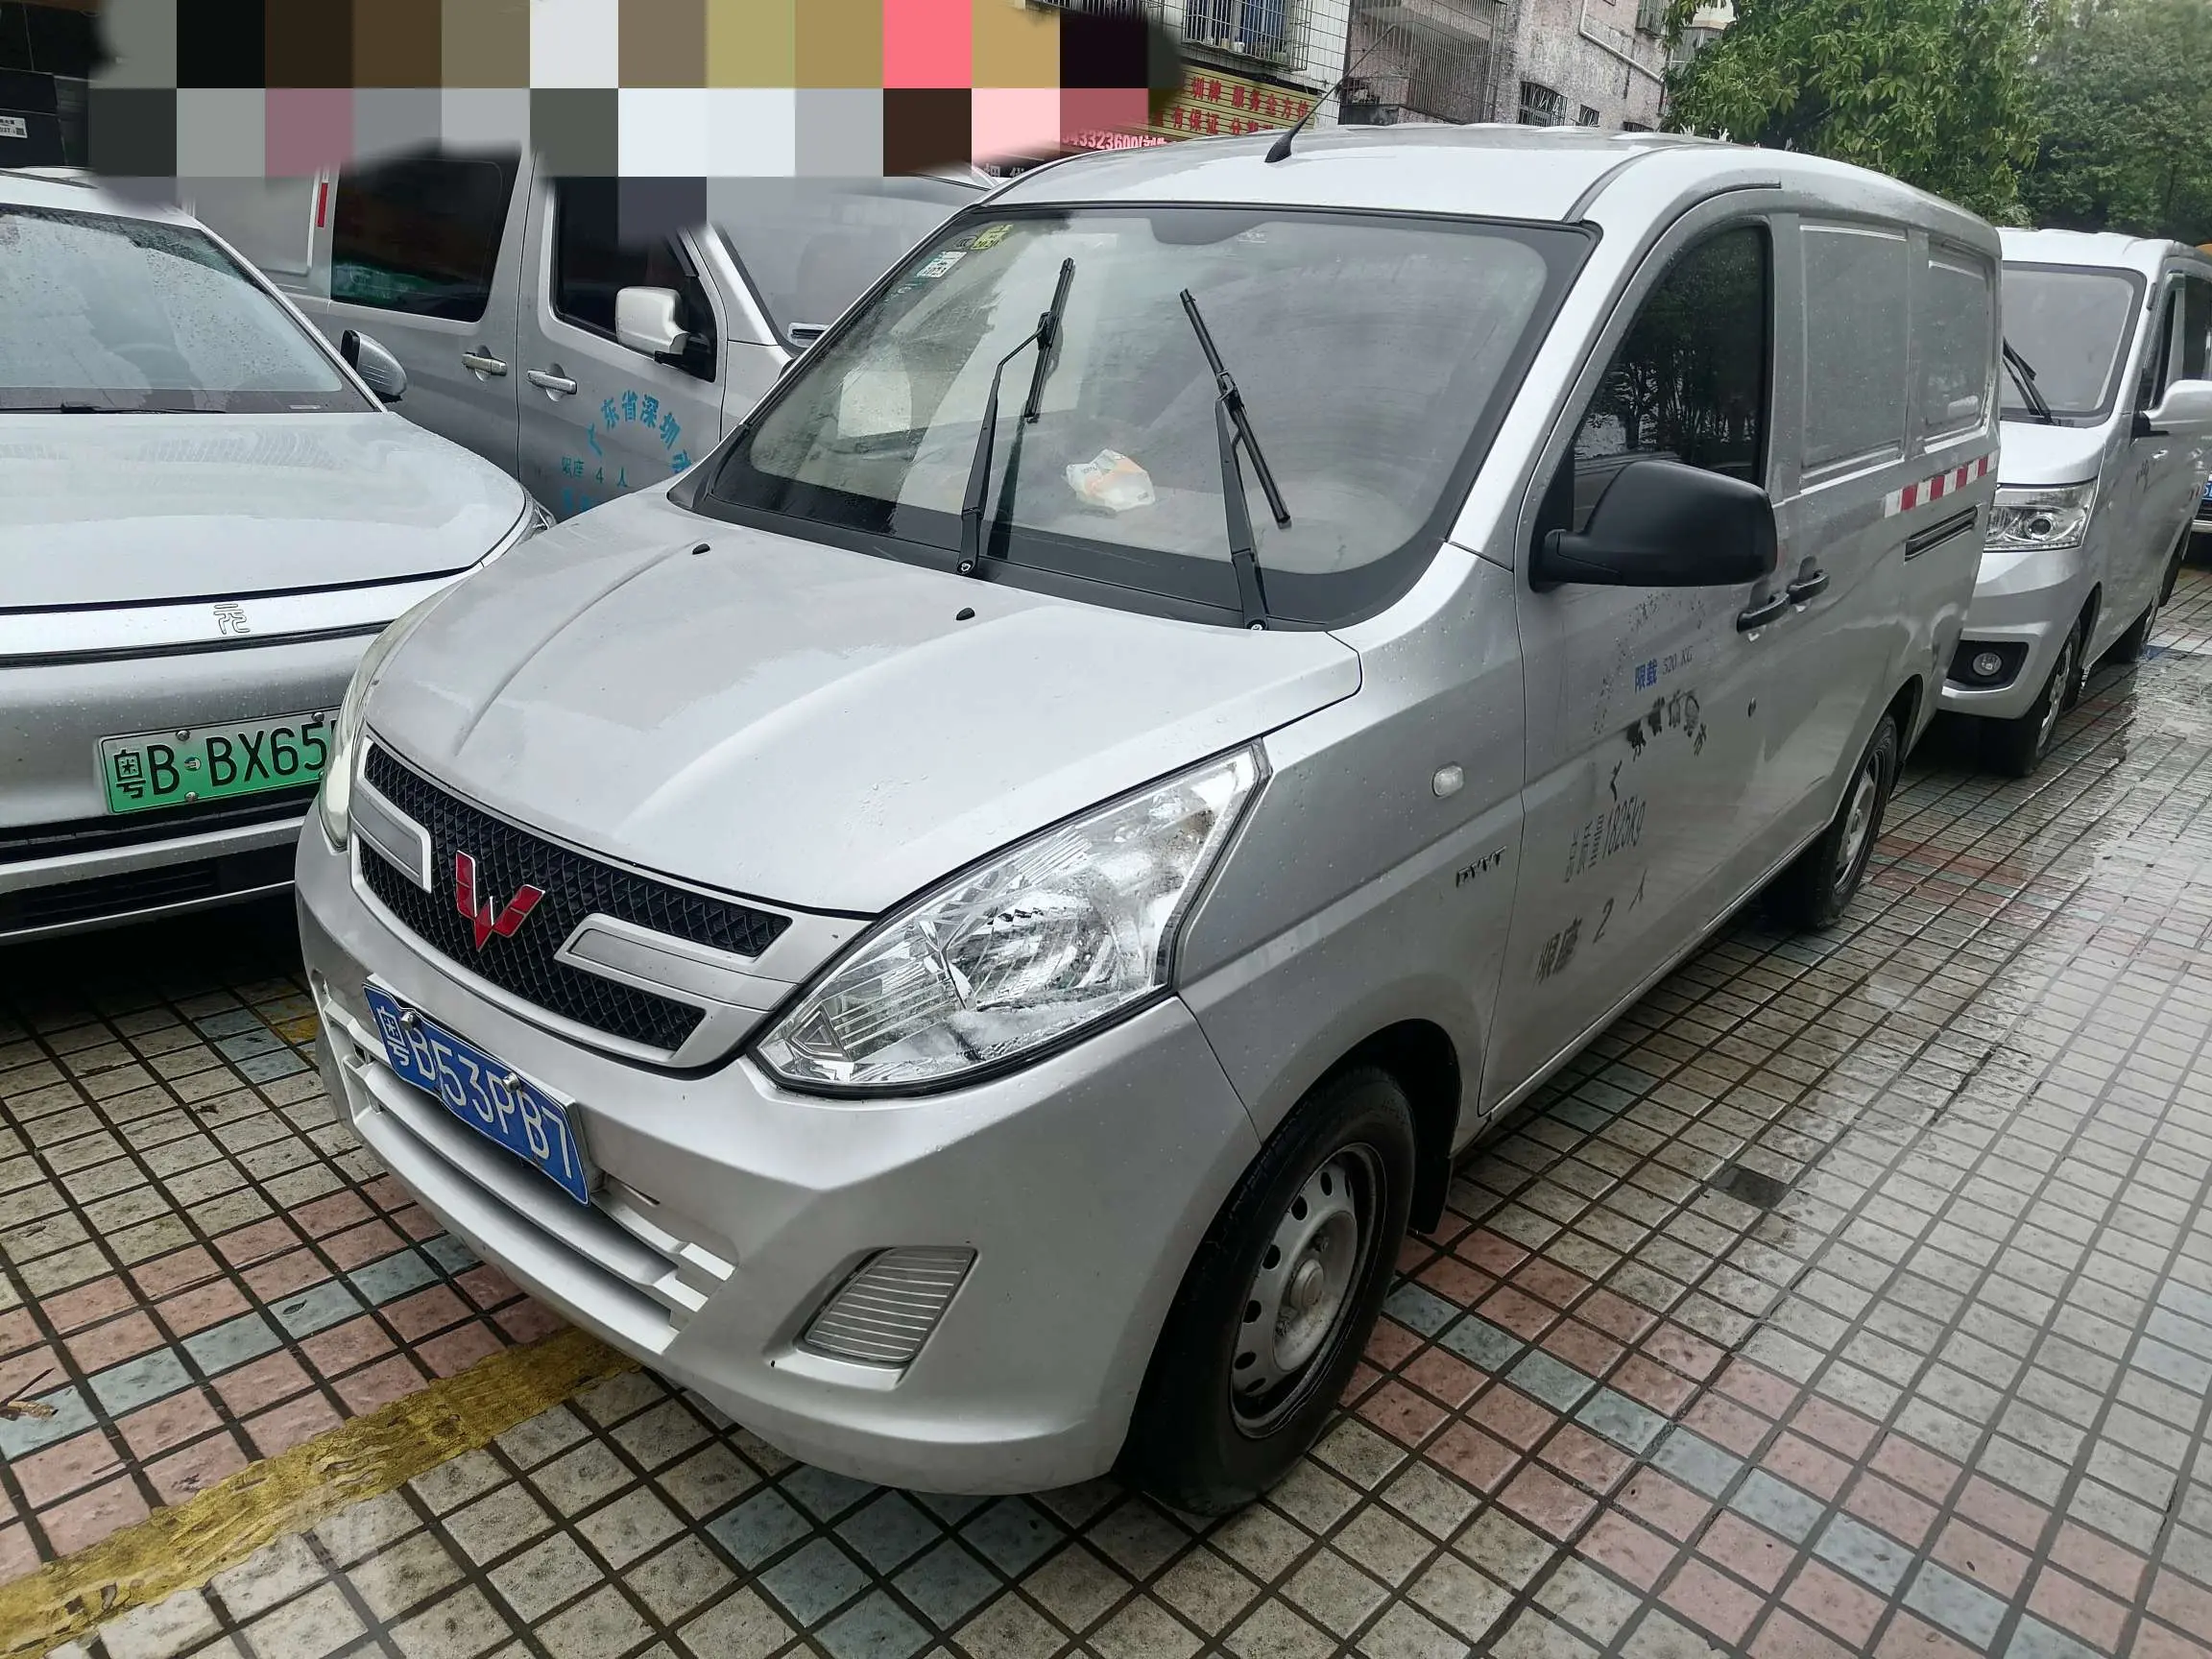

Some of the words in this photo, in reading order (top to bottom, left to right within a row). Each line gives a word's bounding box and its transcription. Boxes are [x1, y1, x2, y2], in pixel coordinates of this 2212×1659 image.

[595, 467, 604, 484] 4
[616, 467, 628, 487] 人
[213, 603, 250, 635] 元
[1634, 657, 1659, 694] 限载
[113, 720, 337, 800] 粤BBX65
[1593, 897, 1614, 945] 2
[376, 1004, 573, 1180] 粤B53PB7
